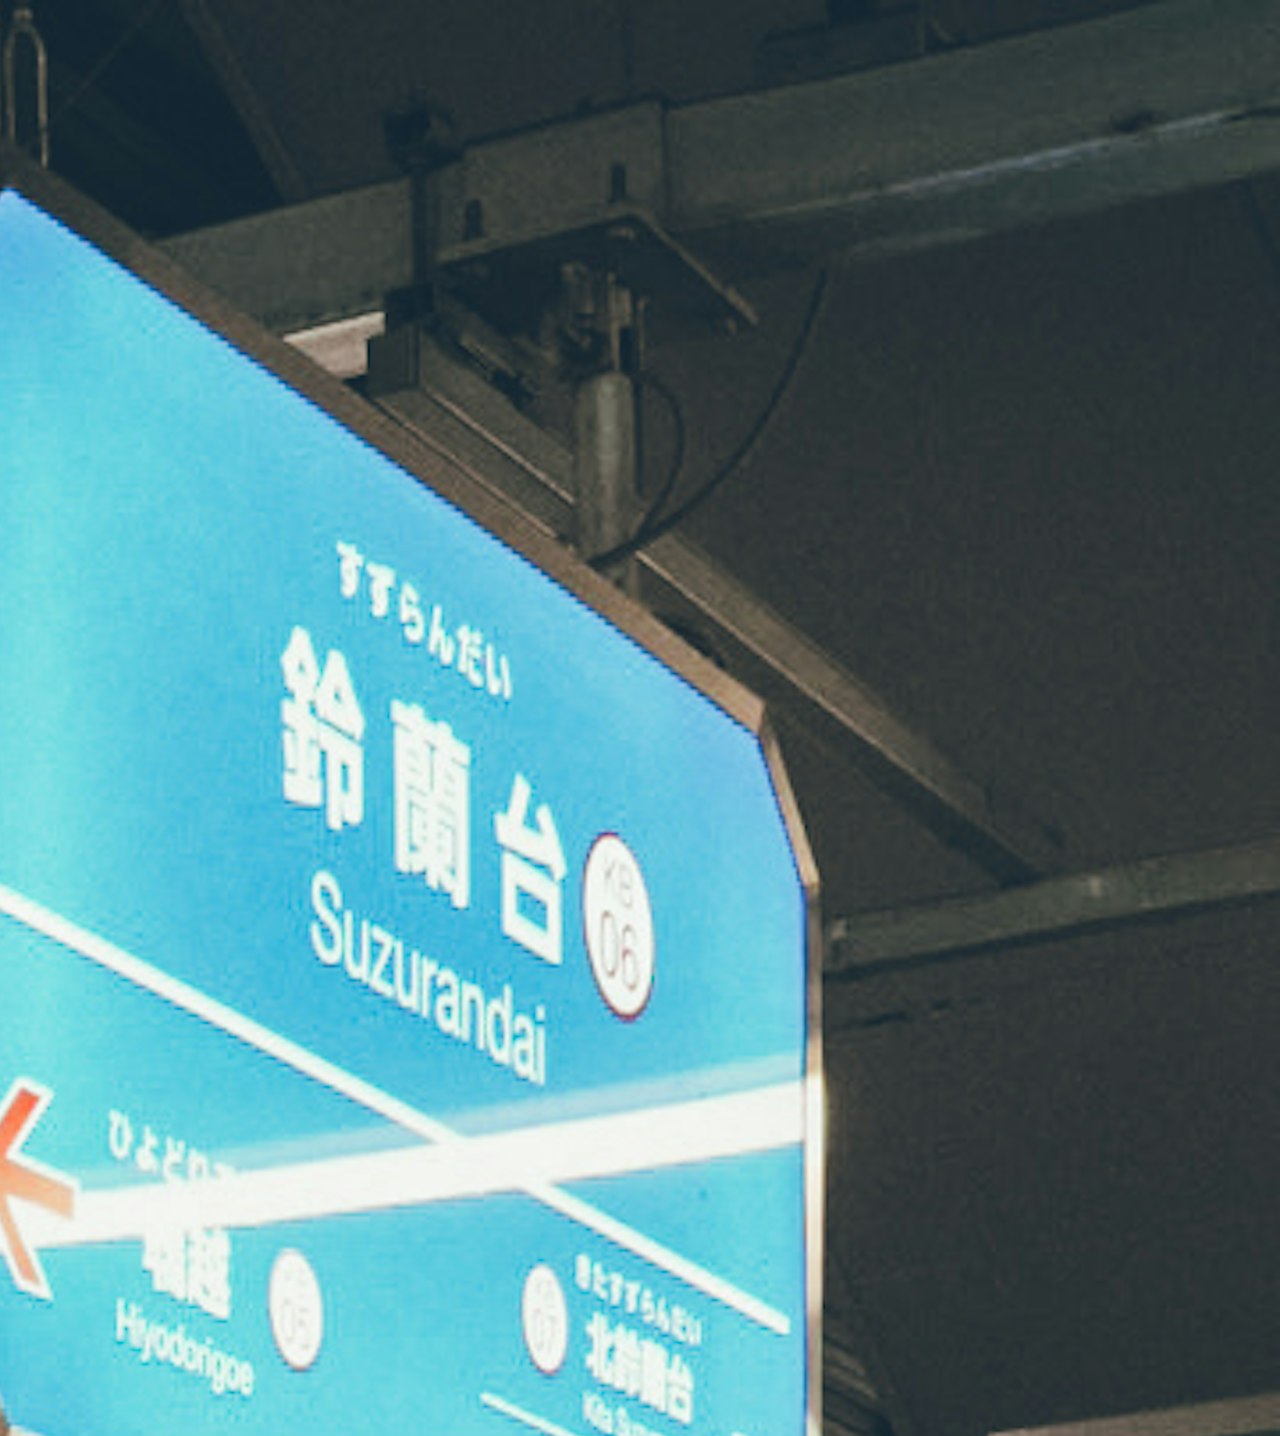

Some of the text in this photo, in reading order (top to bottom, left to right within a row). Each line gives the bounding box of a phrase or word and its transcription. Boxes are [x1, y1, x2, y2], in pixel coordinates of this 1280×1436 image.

[336, 540, 513, 702] すずらんだい
[280, 626, 568, 965] 鈴蘭台
[309, 871, 547, 1086] Suzurandai
[600, 910, 640, 992] 06
[114, 1297, 255, 1397] Hiyodorigoe
